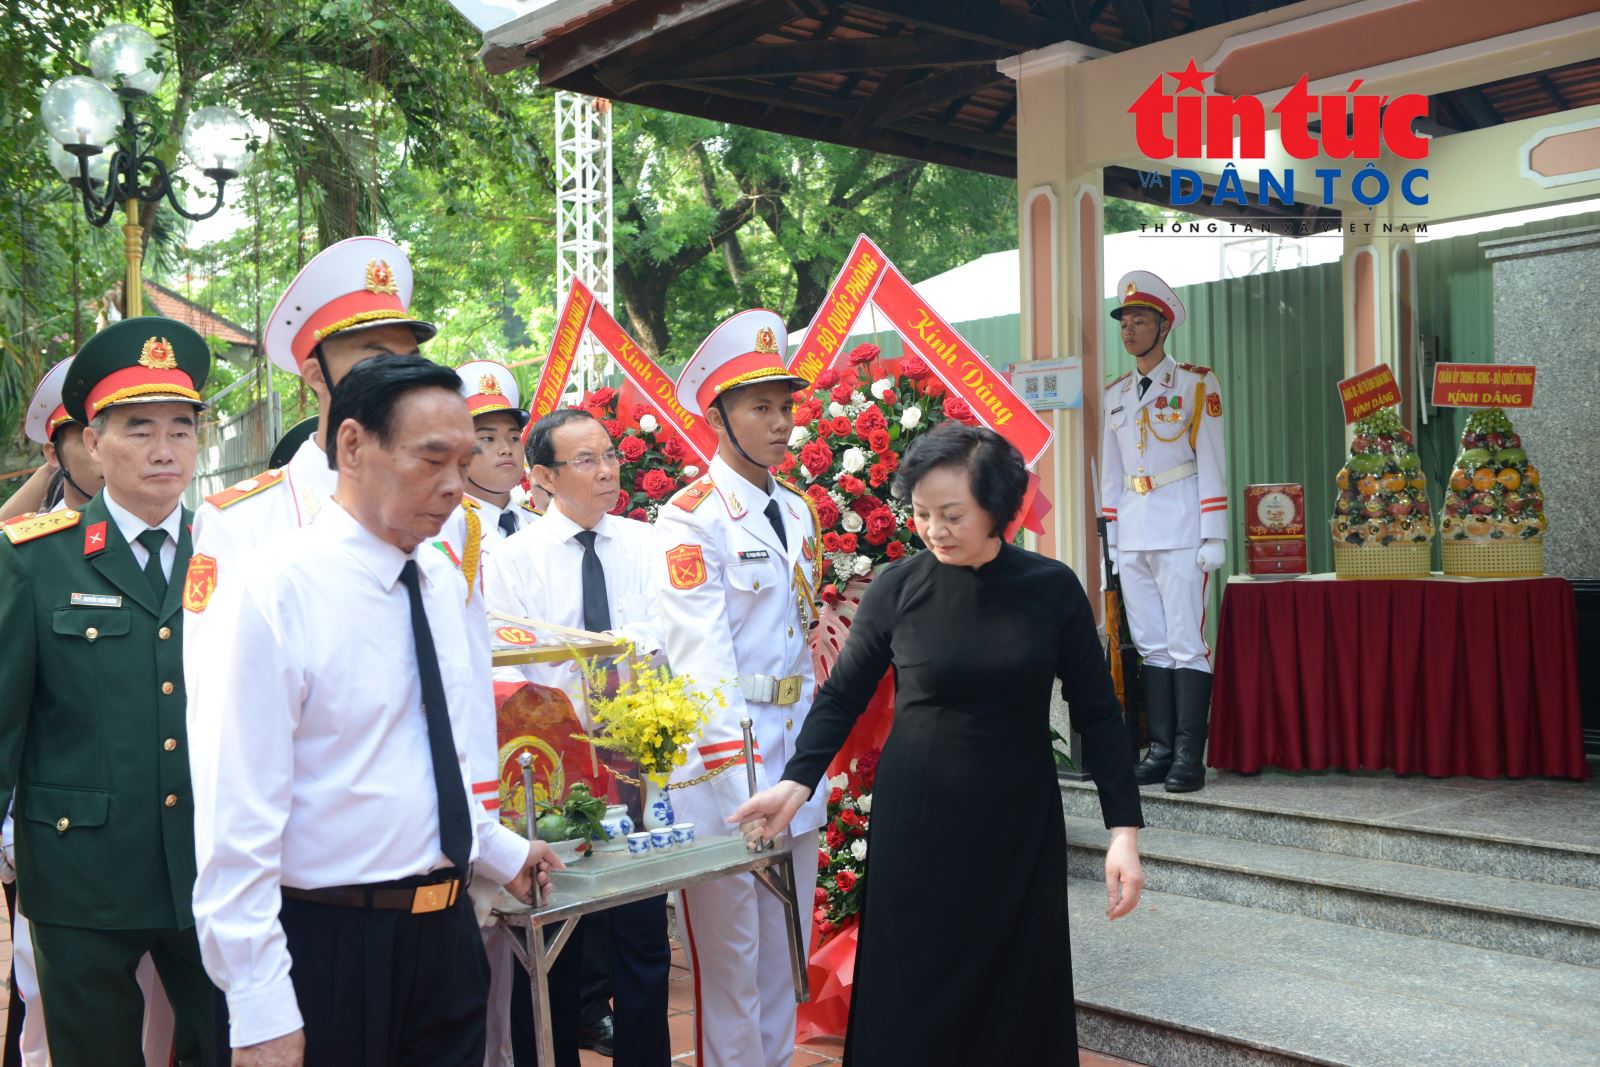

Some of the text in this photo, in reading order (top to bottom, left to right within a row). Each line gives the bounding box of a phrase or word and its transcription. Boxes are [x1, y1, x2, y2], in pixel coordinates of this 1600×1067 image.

[844, 253, 879, 304] PHÒNG
[575, 289, 588, 307] 7
[826, 290, 856, 335] QUỐC
[567, 299, 585, 333] KHU
[558, 325, 578, 362] QUÂN
[816, 323, 841, 354] BỘ
[548, 354, 569, 391] LỆNH
[960, 360, 1014, 427] Dâng
[1447, 389, 1522, 405] KÍNH DÂNG
[499, 629, 534, 643] 02
